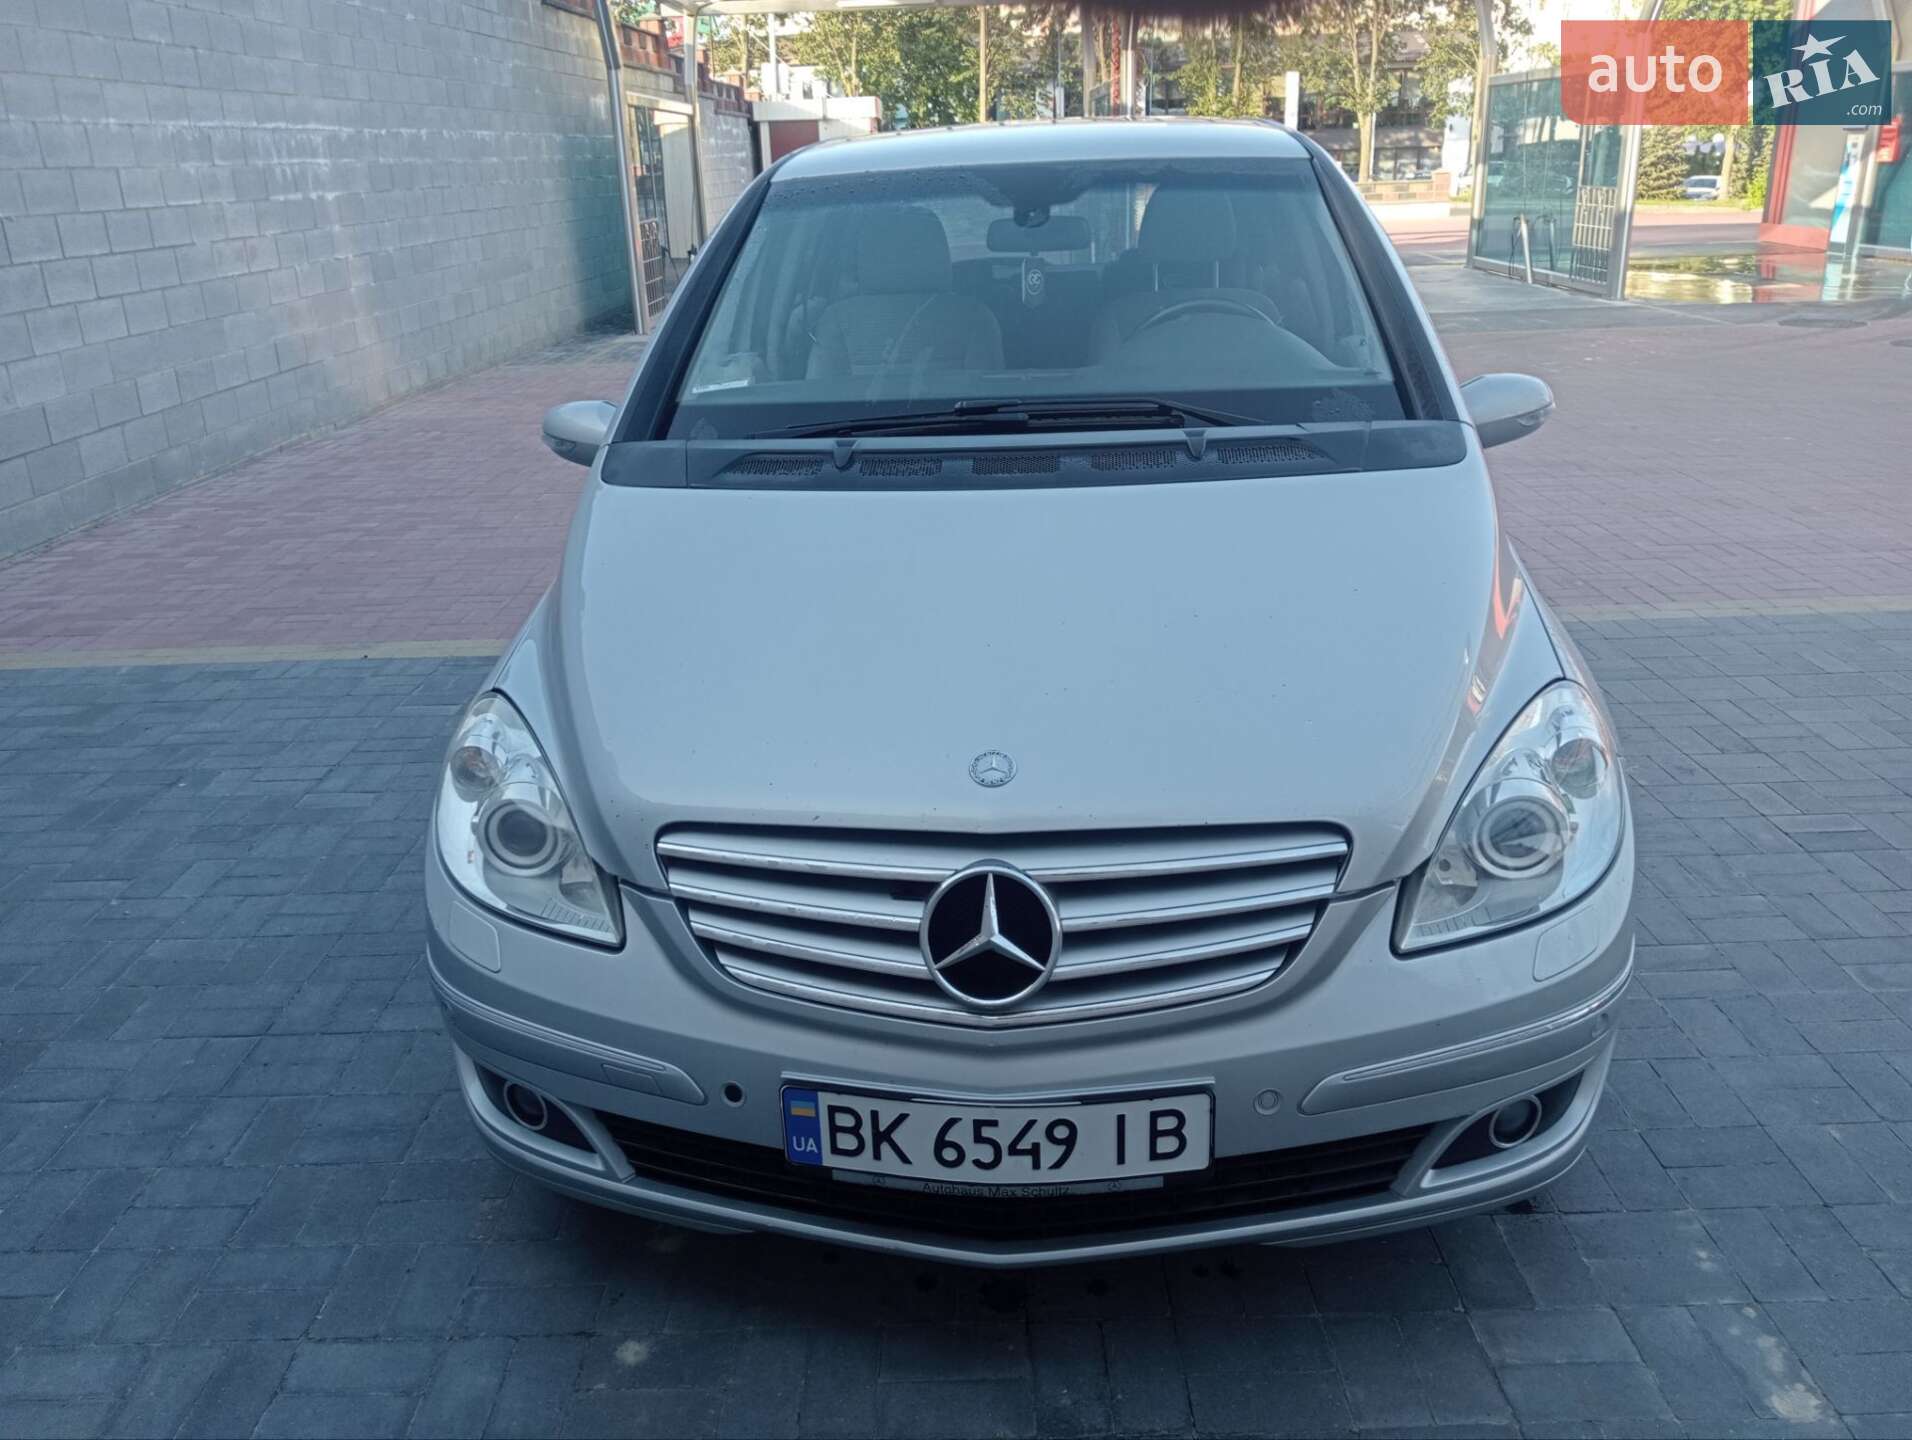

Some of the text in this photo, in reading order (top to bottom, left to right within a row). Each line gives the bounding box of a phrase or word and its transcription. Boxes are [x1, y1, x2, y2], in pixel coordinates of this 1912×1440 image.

[792, 1135, 819, 1154] UA
[827, 1104, 1188, 1170] BK 6549 IB
